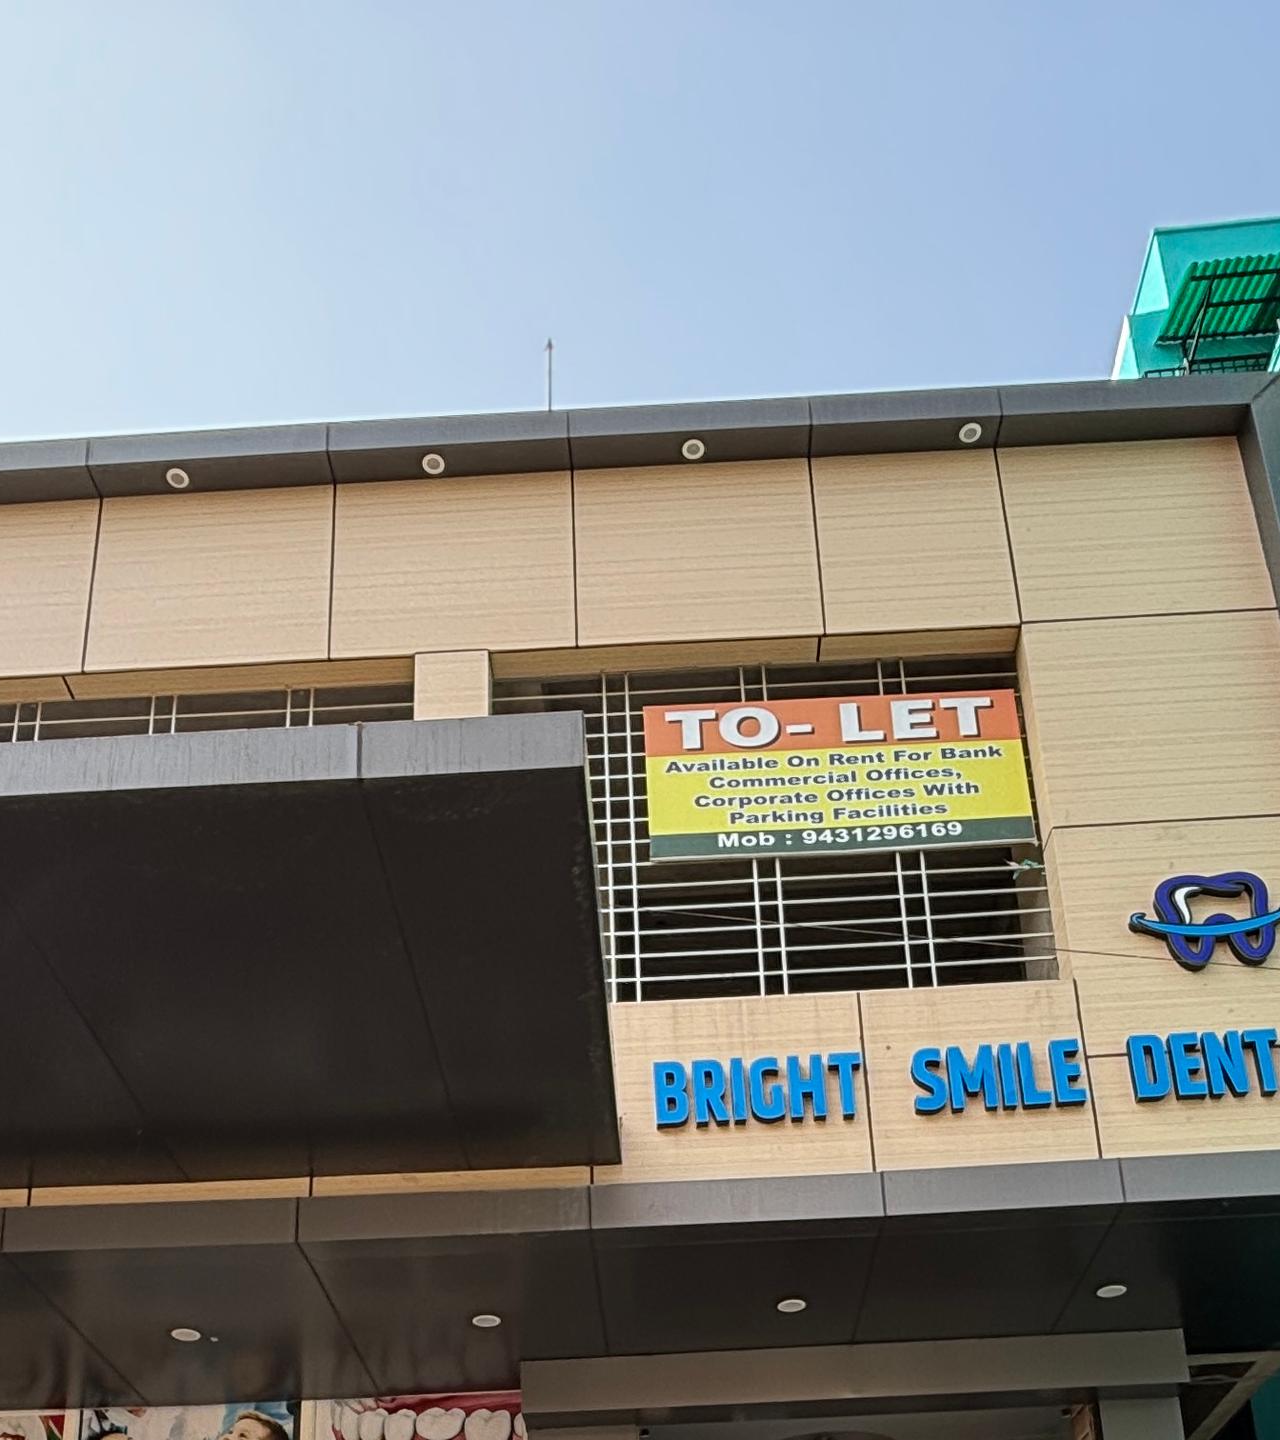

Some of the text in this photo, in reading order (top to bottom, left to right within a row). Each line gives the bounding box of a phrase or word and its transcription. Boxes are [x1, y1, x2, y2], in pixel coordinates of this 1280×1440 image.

[664, 696, 992, 750] TO- LET
[665, 745, 1003, 774] Available On Rent For Bank
[709, 766, 963, 790] Commercial Offices,
[694, 781, 980, 810] Corporate Offices With
[729, 801, 948, 826] Parking Facilities
[718, 831, 776, 849] Mob
[801, 821, 963, 845] 9431296169
[652, 1051, 863, 1130] BRIGHT
[910, 1037, 1088, 1116] SMILE
